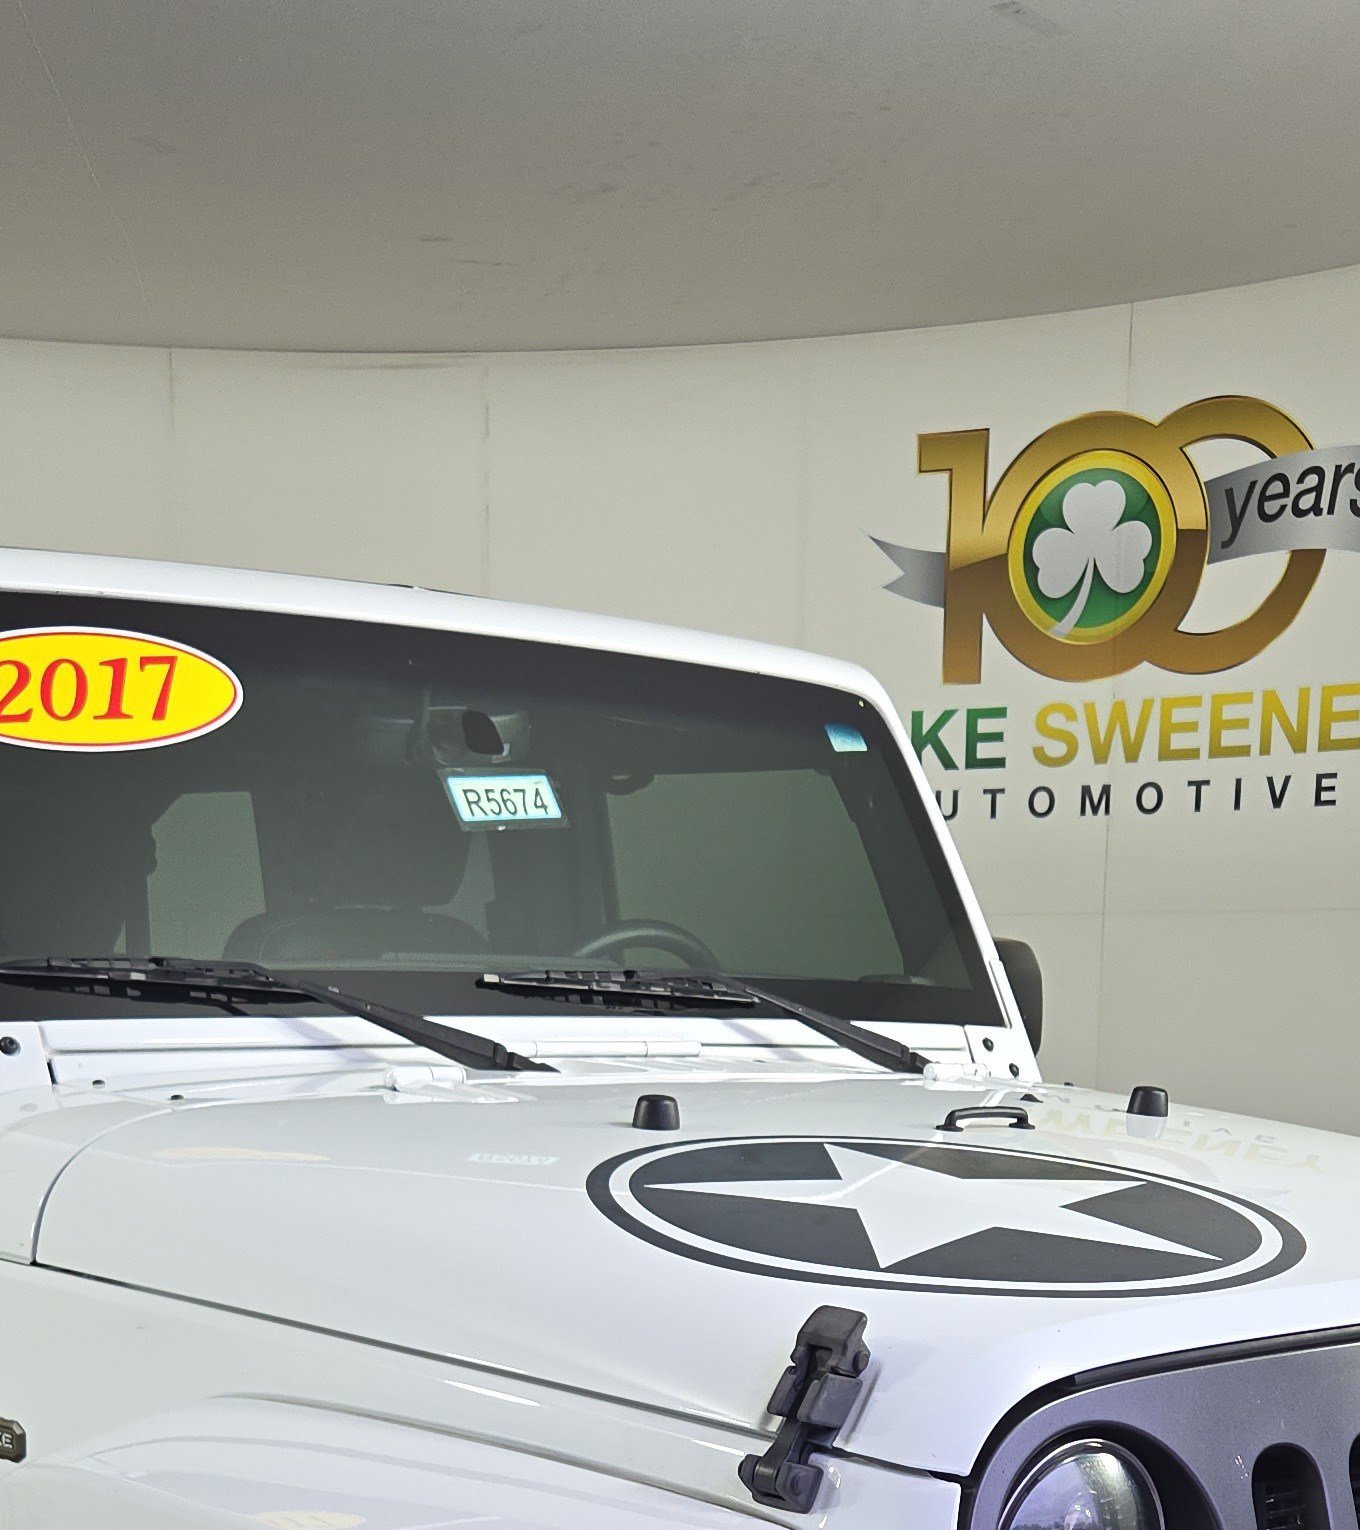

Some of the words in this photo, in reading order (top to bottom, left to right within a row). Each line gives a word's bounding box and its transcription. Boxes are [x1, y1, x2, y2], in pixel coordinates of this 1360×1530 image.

[917, 394, 1328, 685] 100
[910, 707, 1007, 771] KE
[462, 788, 548, 817] R5674
[935, 772, 1338, 821] UTOMOTIVE
